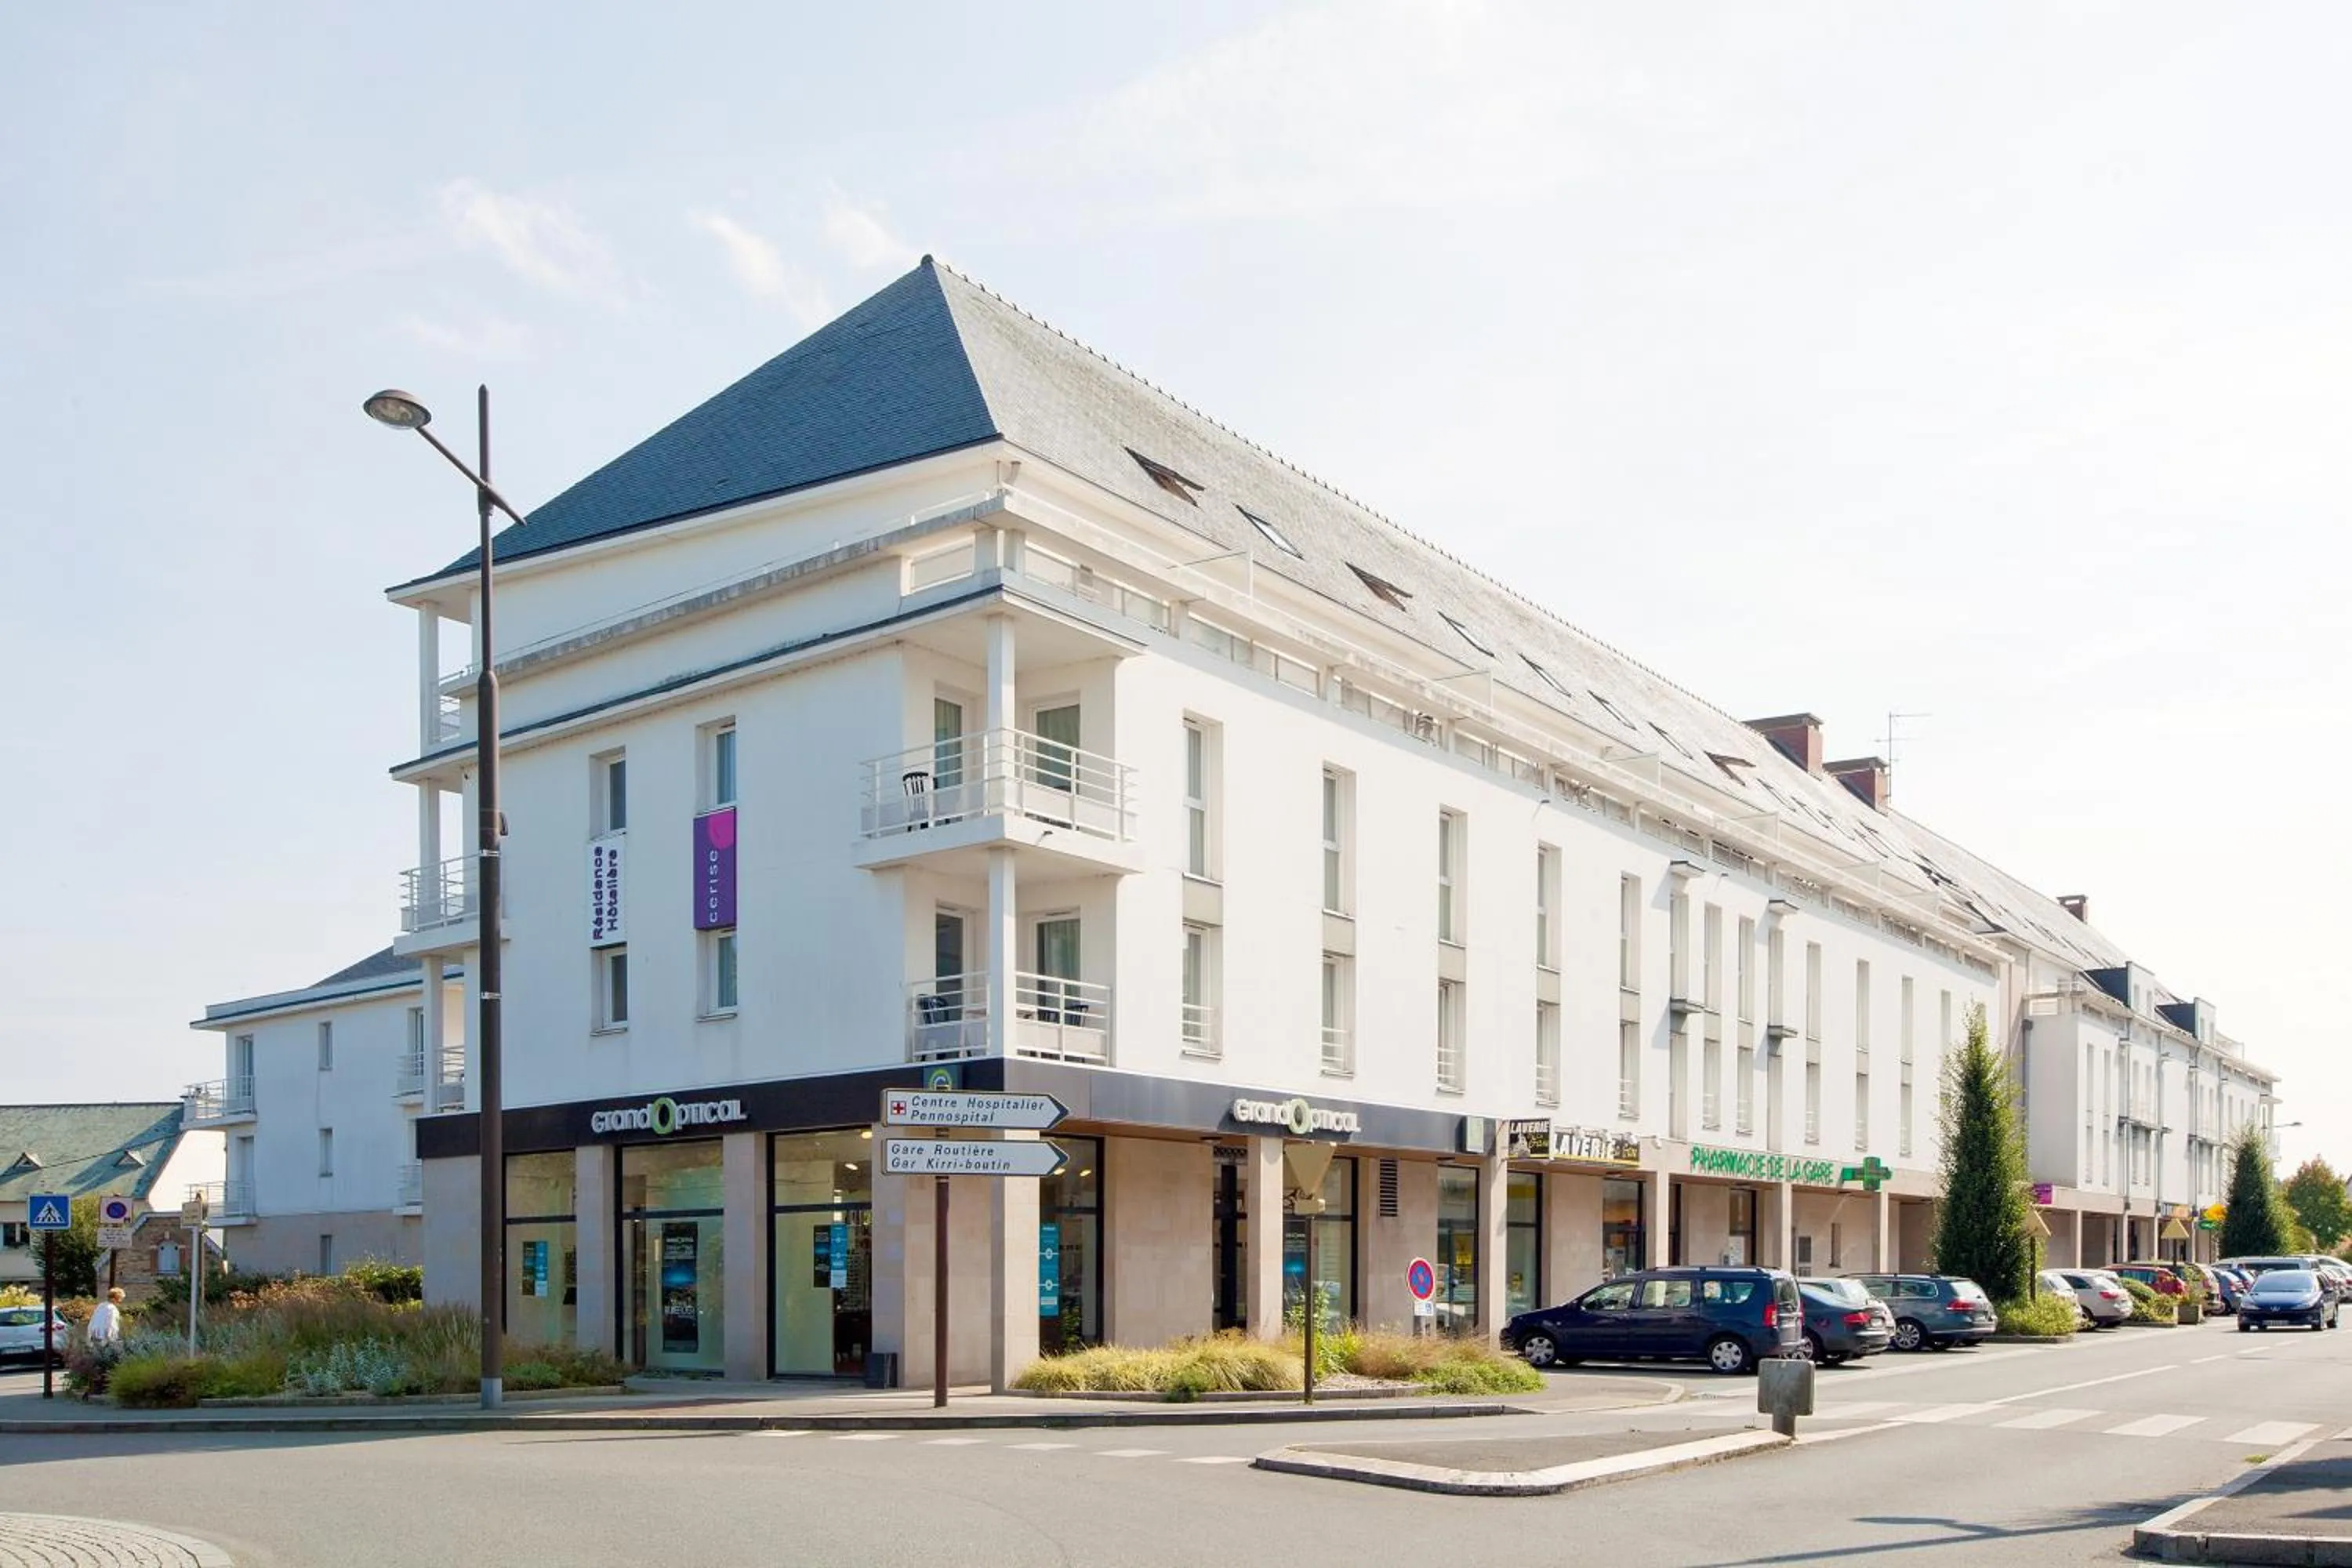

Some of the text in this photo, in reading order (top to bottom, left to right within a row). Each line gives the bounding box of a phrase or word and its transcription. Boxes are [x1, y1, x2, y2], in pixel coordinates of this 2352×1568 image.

[593, 846, 603, 940] Résidence
[607, 849, 618, 931] Hôtelière
[710, 850, 719, 923] cerise
[911, 1095, 1045, 1111] Centre Hospitalier
[910, 1110, 995, 1125] Pennospital
[1510, 1121, 1550, 1134] LAVERIE
[891, 1144, 994, 1156] Gare Routière
[1553, 1133, 1615, 1160] LAVERIE
[891, 1157, 1011, 1171] Gar Kirri-boutin
[1690, 1145, 1834, 1185] PHARMACIE DE LA GARE
